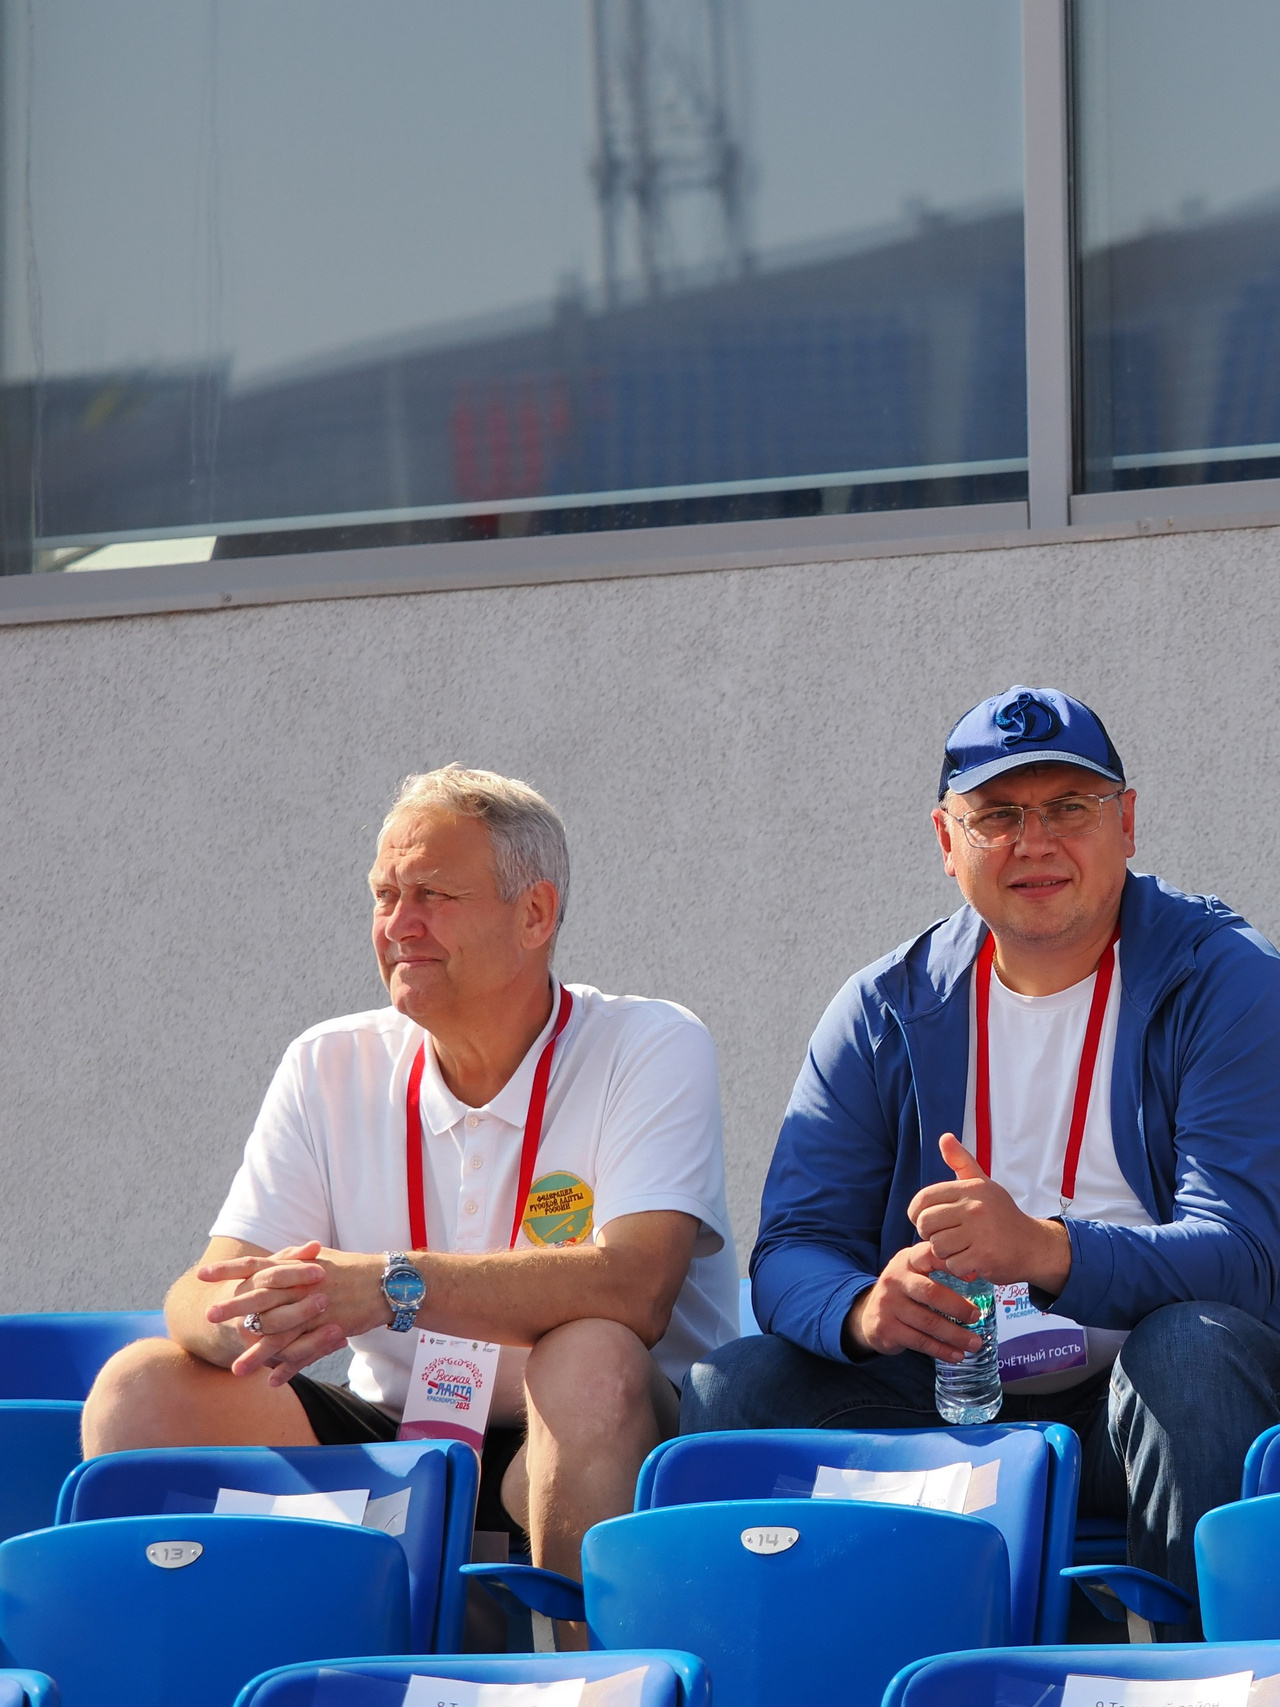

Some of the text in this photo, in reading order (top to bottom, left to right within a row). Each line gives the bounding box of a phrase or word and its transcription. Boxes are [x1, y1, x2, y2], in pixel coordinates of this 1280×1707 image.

[998, 1343, 1081, 1370] ОЧЁТНЫЙ ГОСТЬ
[435, 1381, 472, 1403] ЛАПТА
[455, 1401, 470, 1411] 2025
[759, 1533, 779, 1546] 14
[164, 1547, 183, 1561] 13
